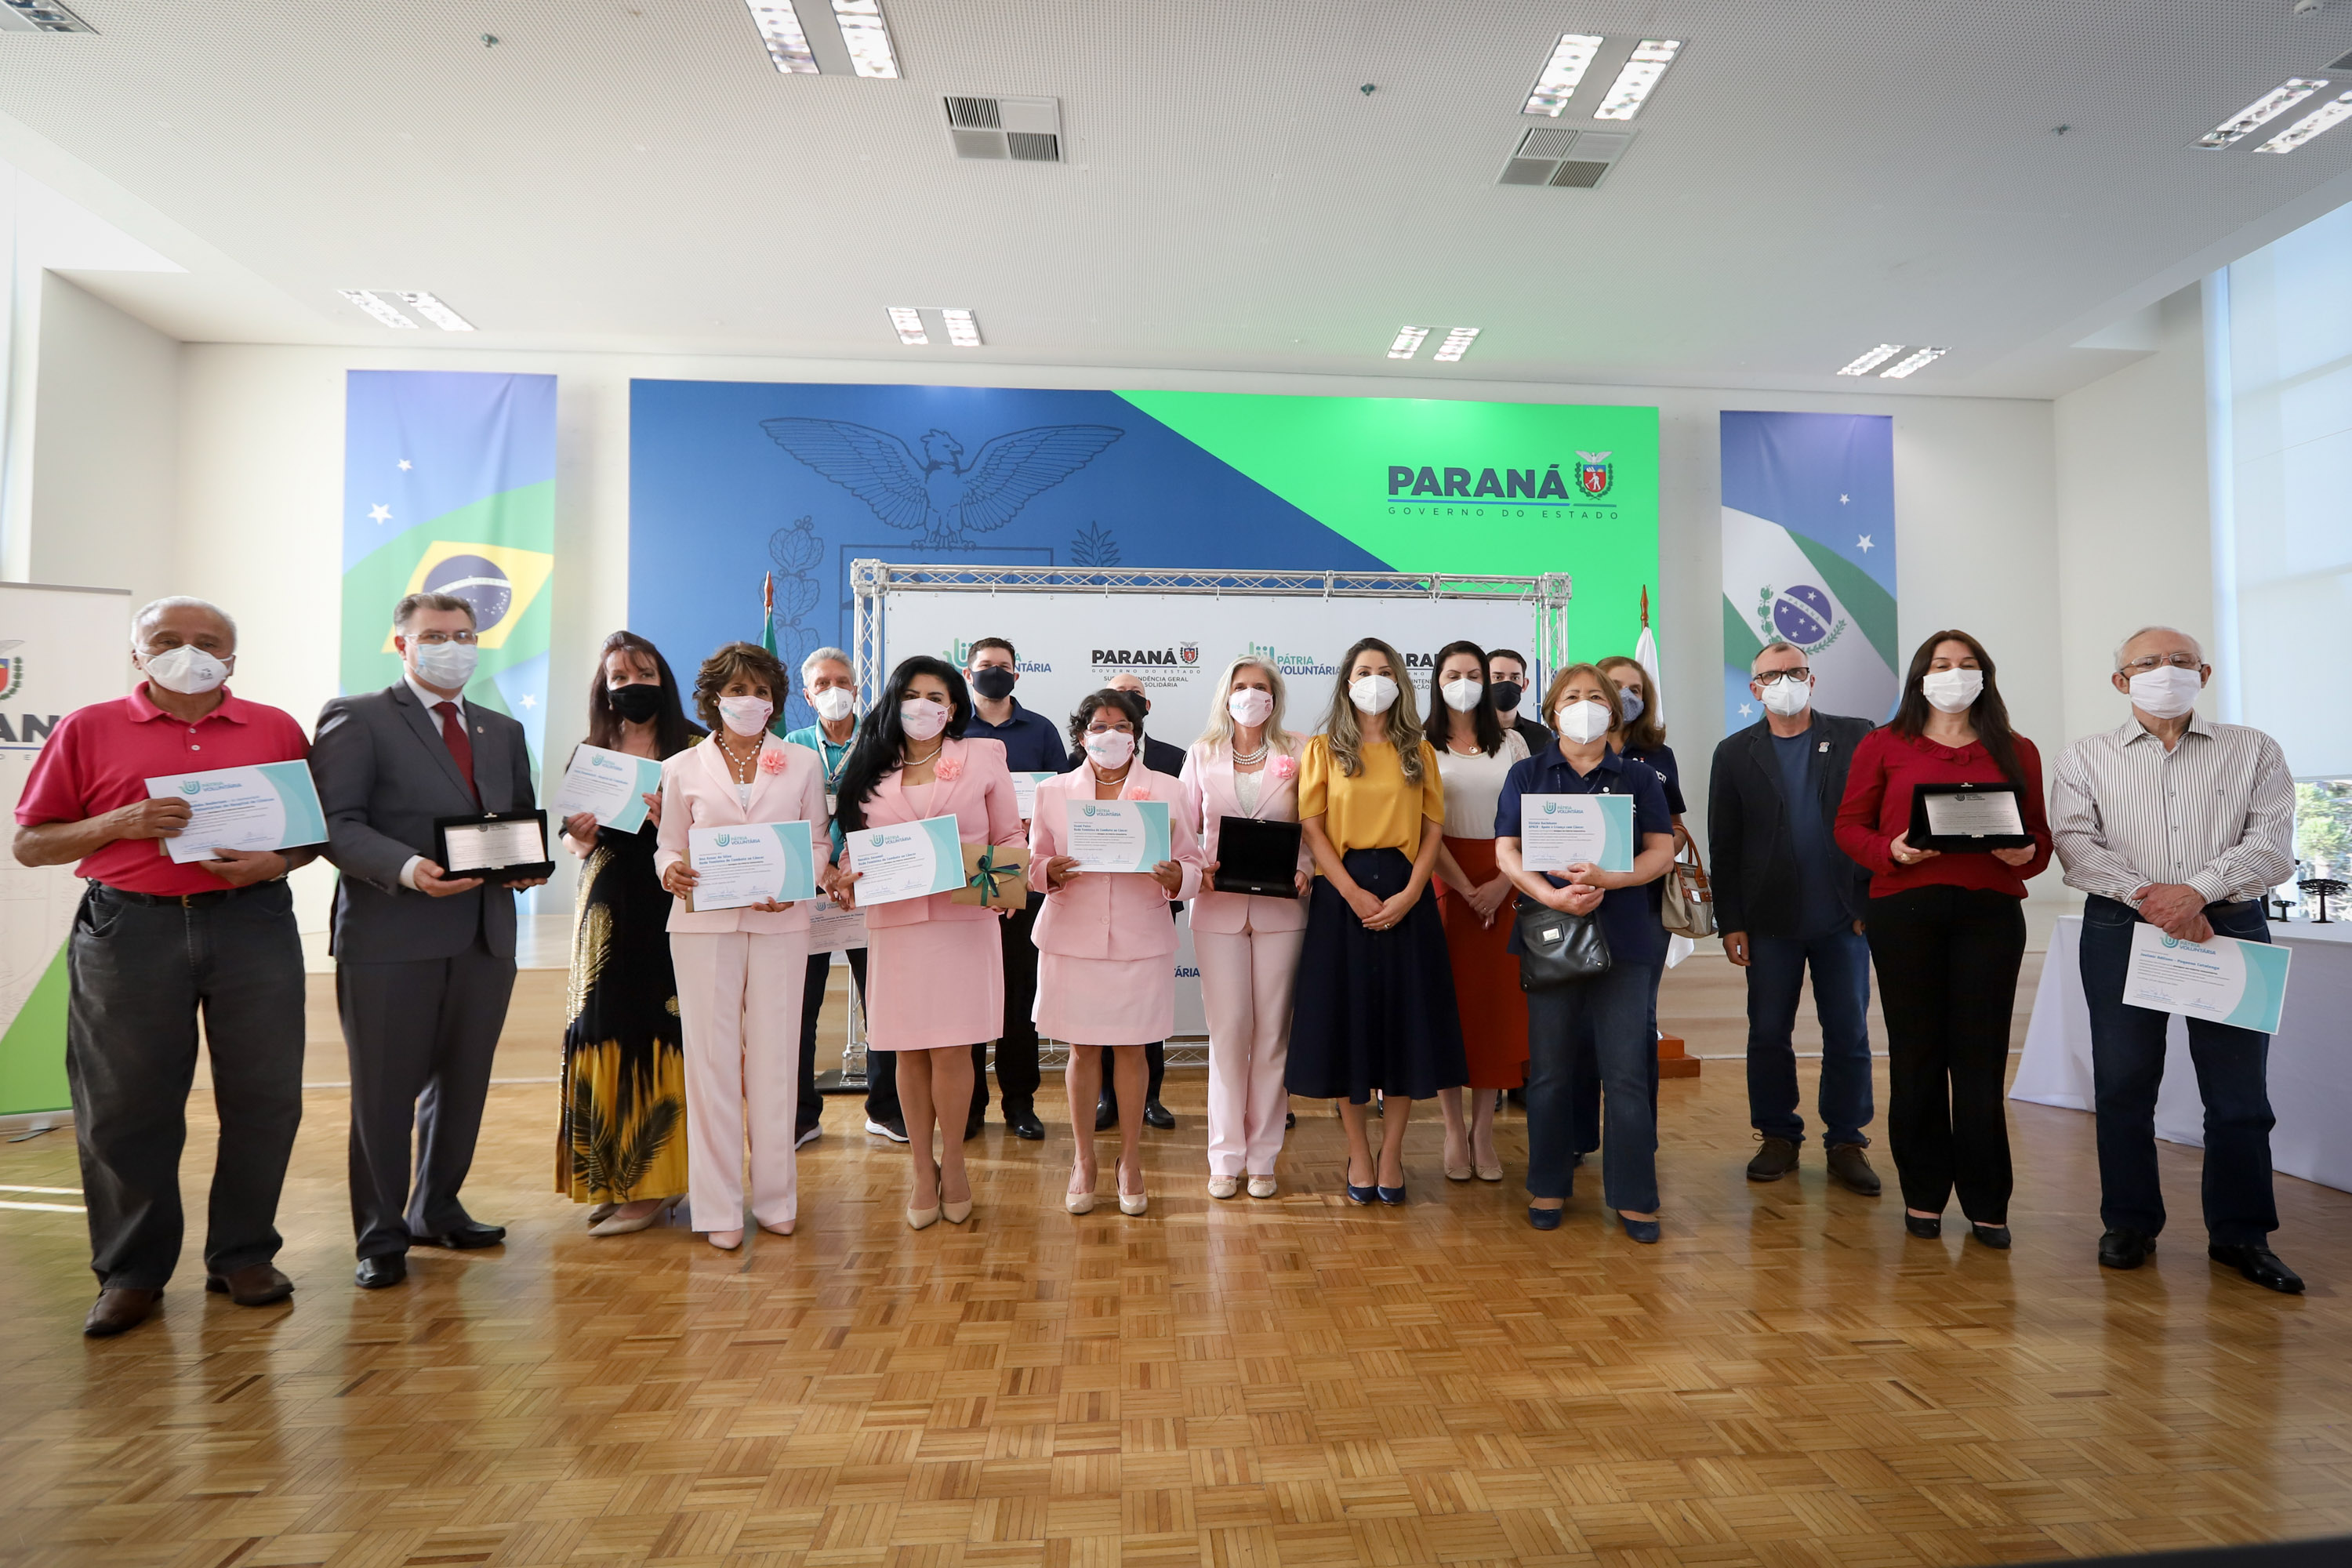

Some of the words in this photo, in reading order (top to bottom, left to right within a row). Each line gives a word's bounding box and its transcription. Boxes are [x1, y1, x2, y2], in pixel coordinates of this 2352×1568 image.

[1388, 463, 1570, 499] PARANÁ
[1388, 506, 1484, 517] GOVERNO
[1502, 509, 1524, 517] DO
[1542, 510, 1618, 520] ESTADO
[1091, 648, 1178, 665] PARANÁ
[1277, 653, 1314, 665] PÁTRIA
[1014, 660, 1051, 673] NTÁRIA
[1277, 663, 1341, 675] VOLUNTÁRIA
[2180, 945, 2216, 955] VOLUNTÁRIA
